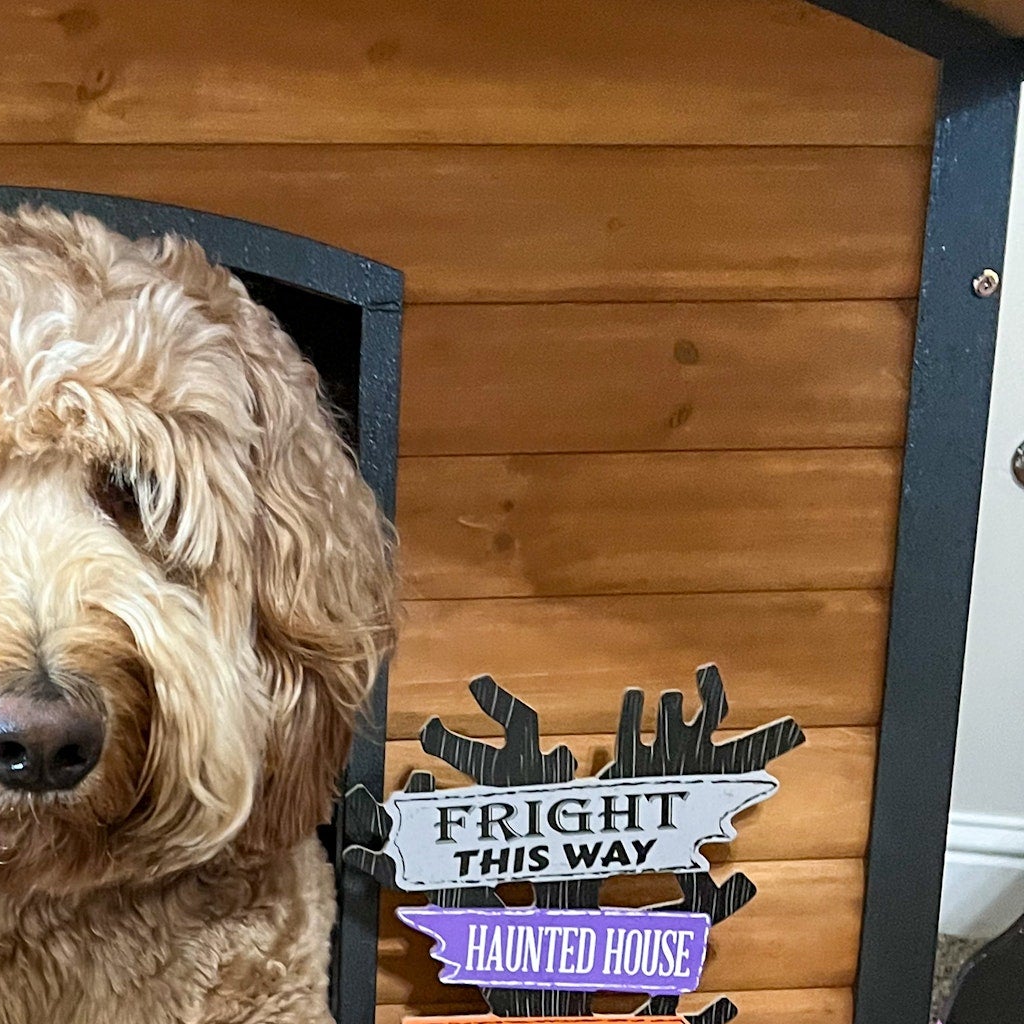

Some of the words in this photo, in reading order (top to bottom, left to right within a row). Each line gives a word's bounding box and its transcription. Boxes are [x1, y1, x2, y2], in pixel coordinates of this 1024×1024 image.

[434, 790, 690, 846] FRIGHT
[453, 844, 550, 878] THIS
[563, 838, 658, 869] WAY
[465, 923, 597, 976] HAUNTED
[602, 926, 694, 978] HOUSE
